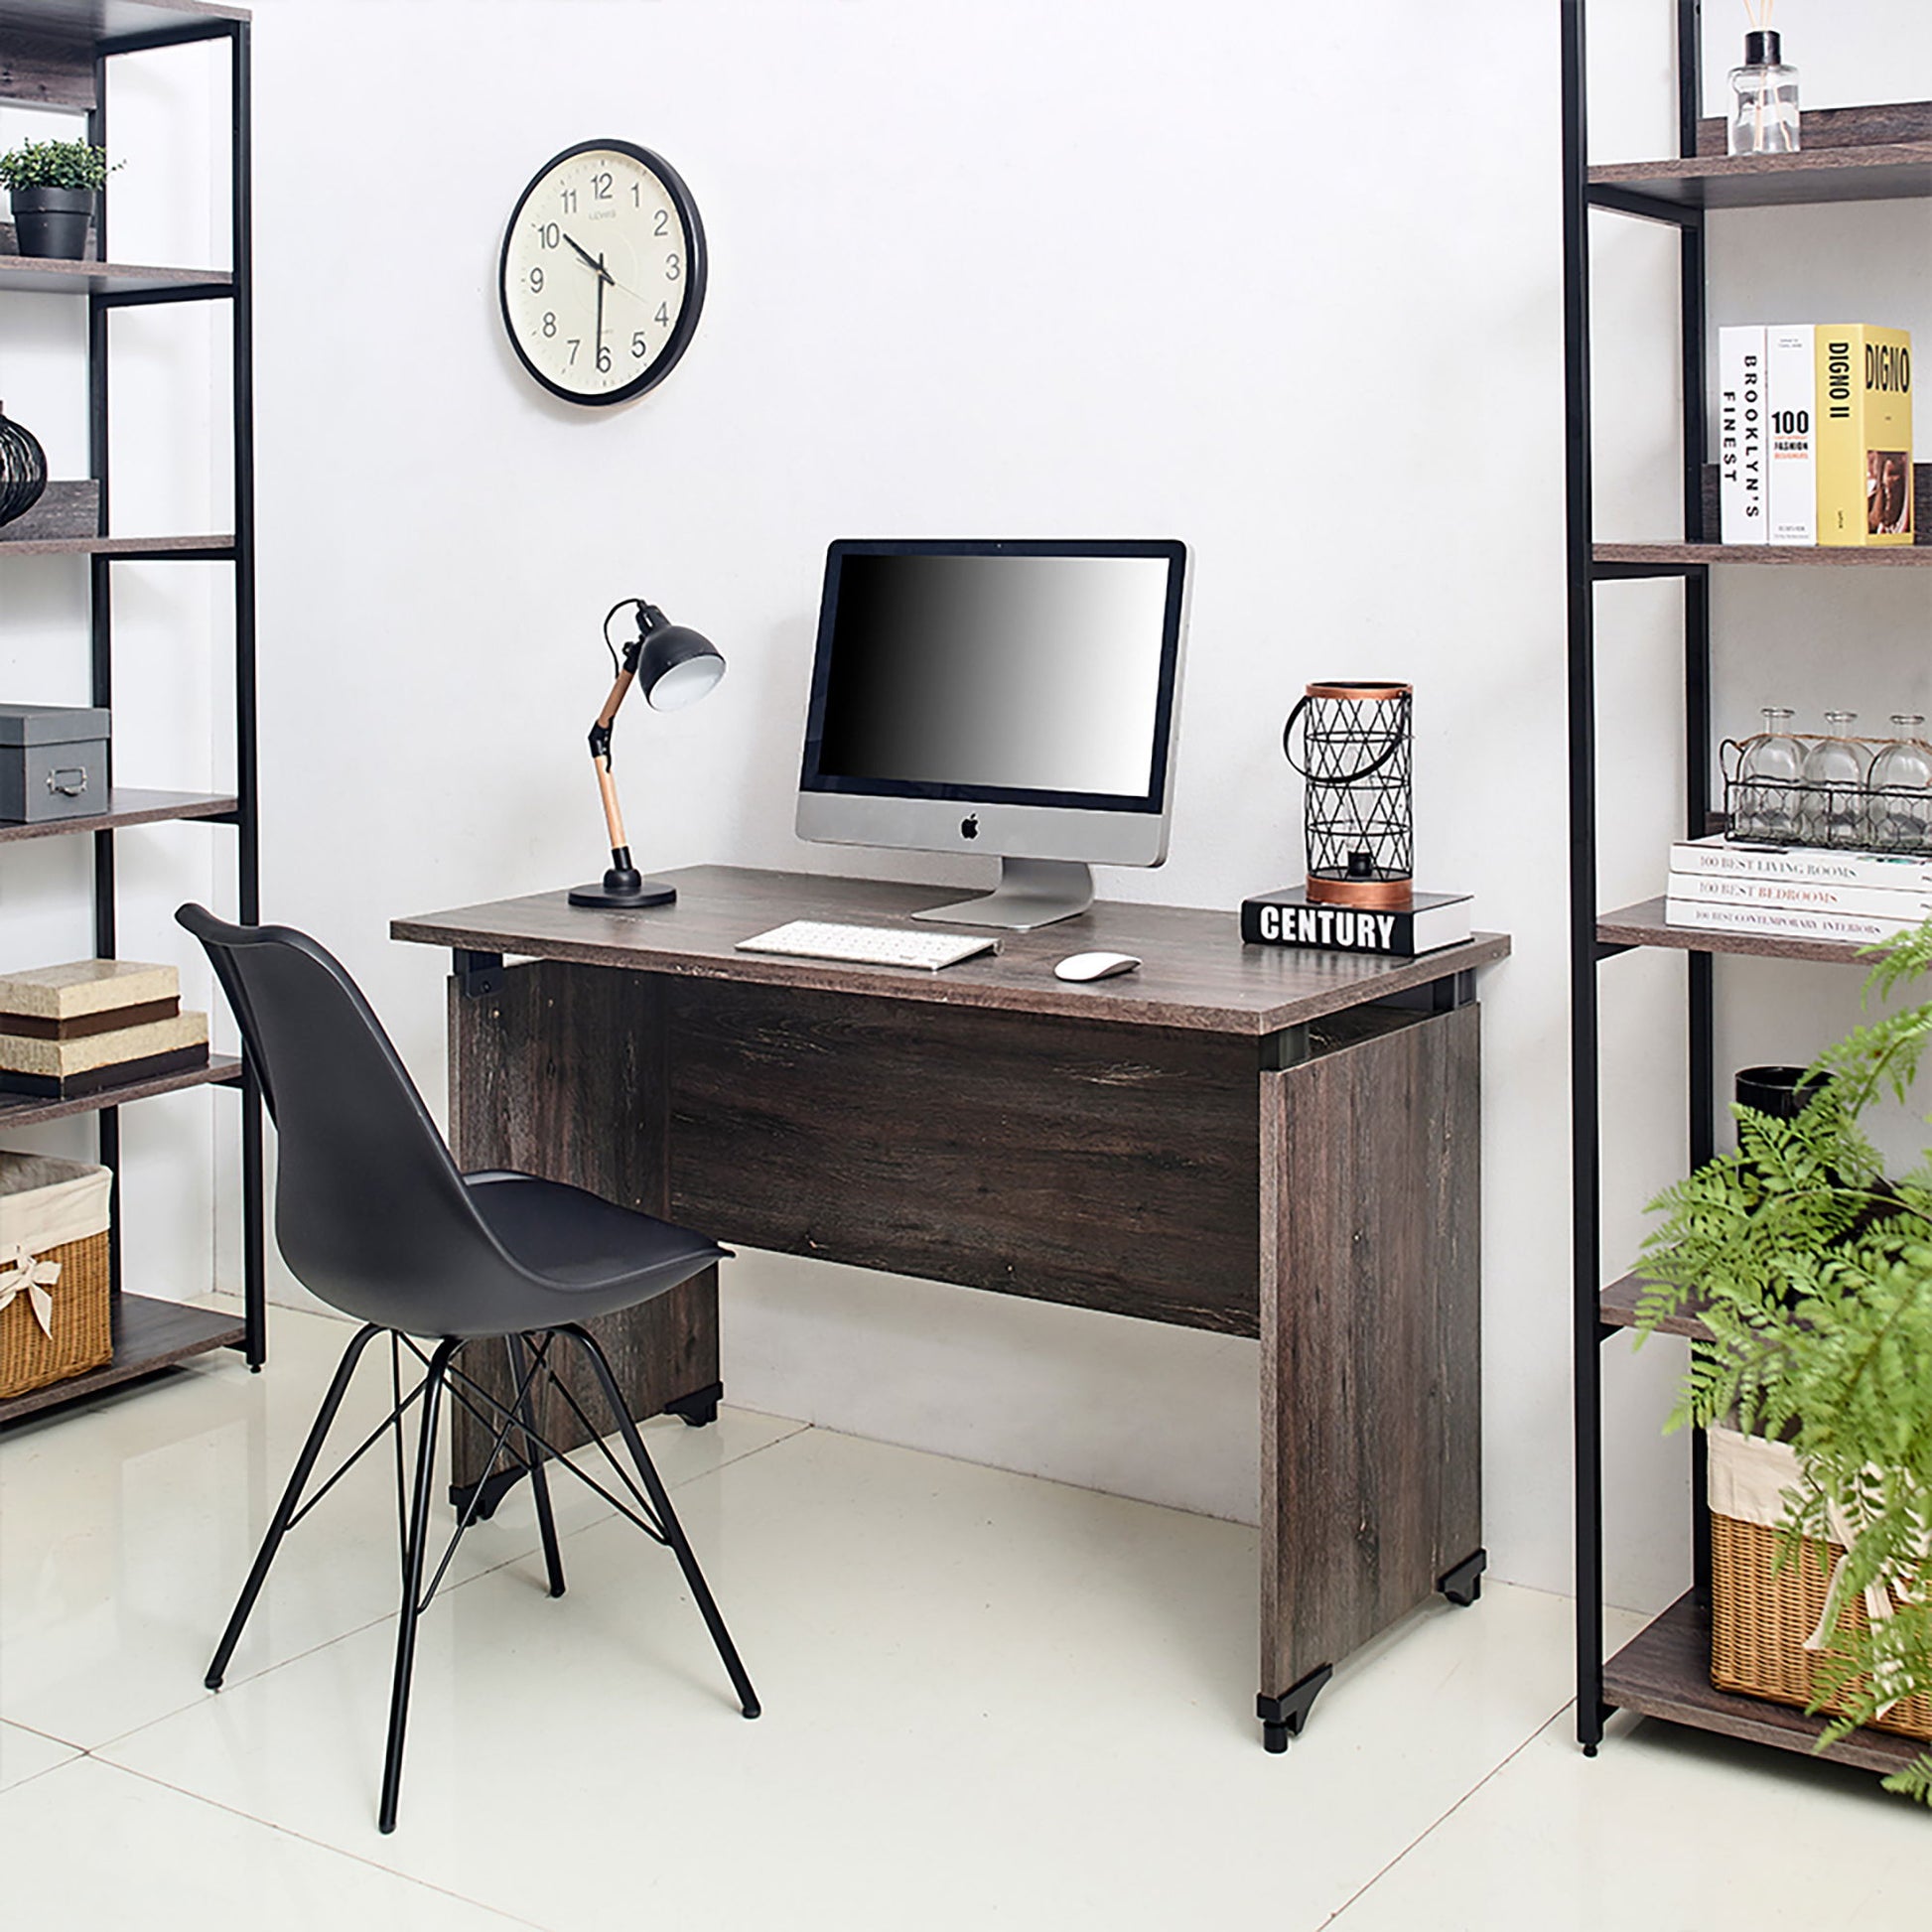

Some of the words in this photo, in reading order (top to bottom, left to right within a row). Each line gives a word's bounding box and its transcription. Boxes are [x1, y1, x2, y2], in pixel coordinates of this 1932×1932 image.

[590, 172, 614, 200] 12
[629, 182, 640, 208] 1
[559, 189, 578, 214] 11
[537, 221, 561, 249] 10
[653, 208, 669, 236] 2
[529, 267, 544, 293] 9
[664, 253, 681, 281] 3
[542, 311, 558, 338] 8
[654, 302, 670, 328] 4
[567, 340, 581, 365] 7
[630, 331, 647, 358] 5
[597, 345, 612, 373] 6
[1829, 343, 1850, 400] DIGNO
[1864, 344, 1910, 393] DIGNO
[1771, 410, 1809, 434] 100
[1830, 406, 1850, 418] II
[1724, 391, 1736, 482] FINEST
[1744, 354, 1759, 517] BROOKLYN'S
[1700, 856, 1719, 868] 100
[1722, 858, 1753, 870] BEST
[1757, 861, 1804, 874] LIVING
[1807, 865, 1857, 878] ROOMS
[1699, 882, 1719, 894] 100
[1722, 884, 1754, 897] BEST
[1758, 887, 1838, 903] BEDROOMS
[1259, 905, 1396, 950] CENTURY
